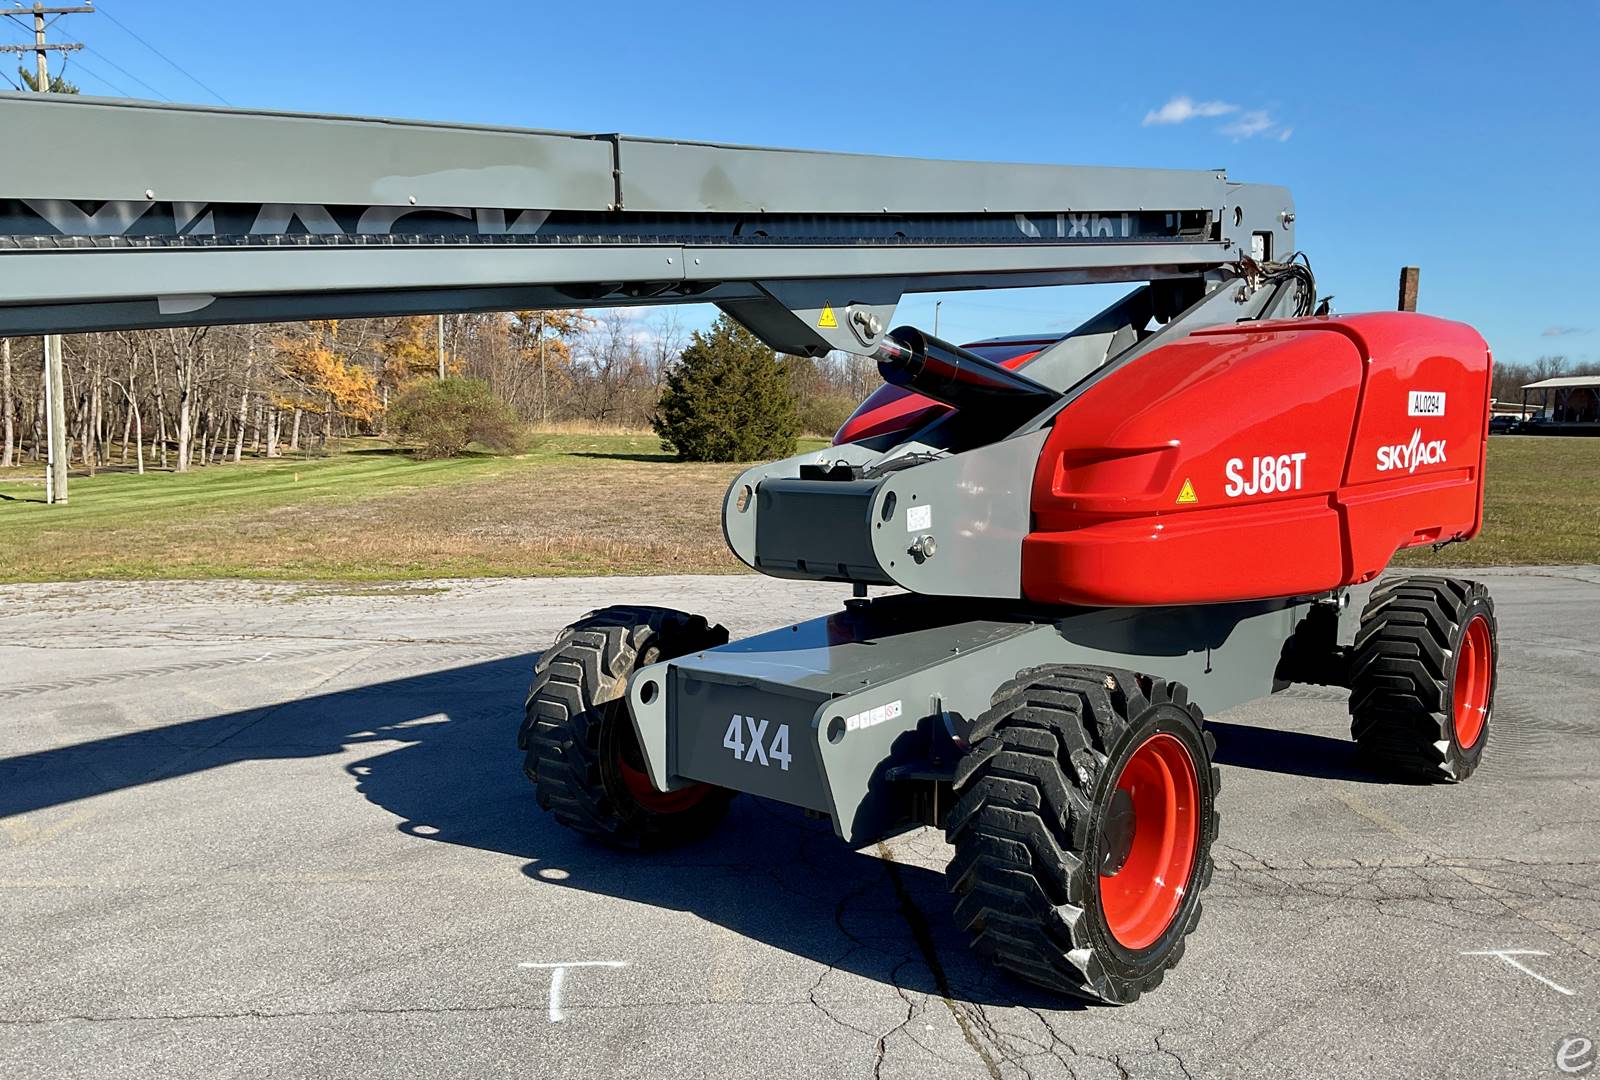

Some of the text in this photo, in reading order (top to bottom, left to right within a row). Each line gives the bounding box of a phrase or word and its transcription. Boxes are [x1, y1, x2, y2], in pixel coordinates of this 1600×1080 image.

[1414, 394, 1439, 413] AL0294
[1376, 427, 1447, 474] SKYJACK
[1225, 452, 1307, 497] SJ86T
[723, 714, 792, 771] 4X4
